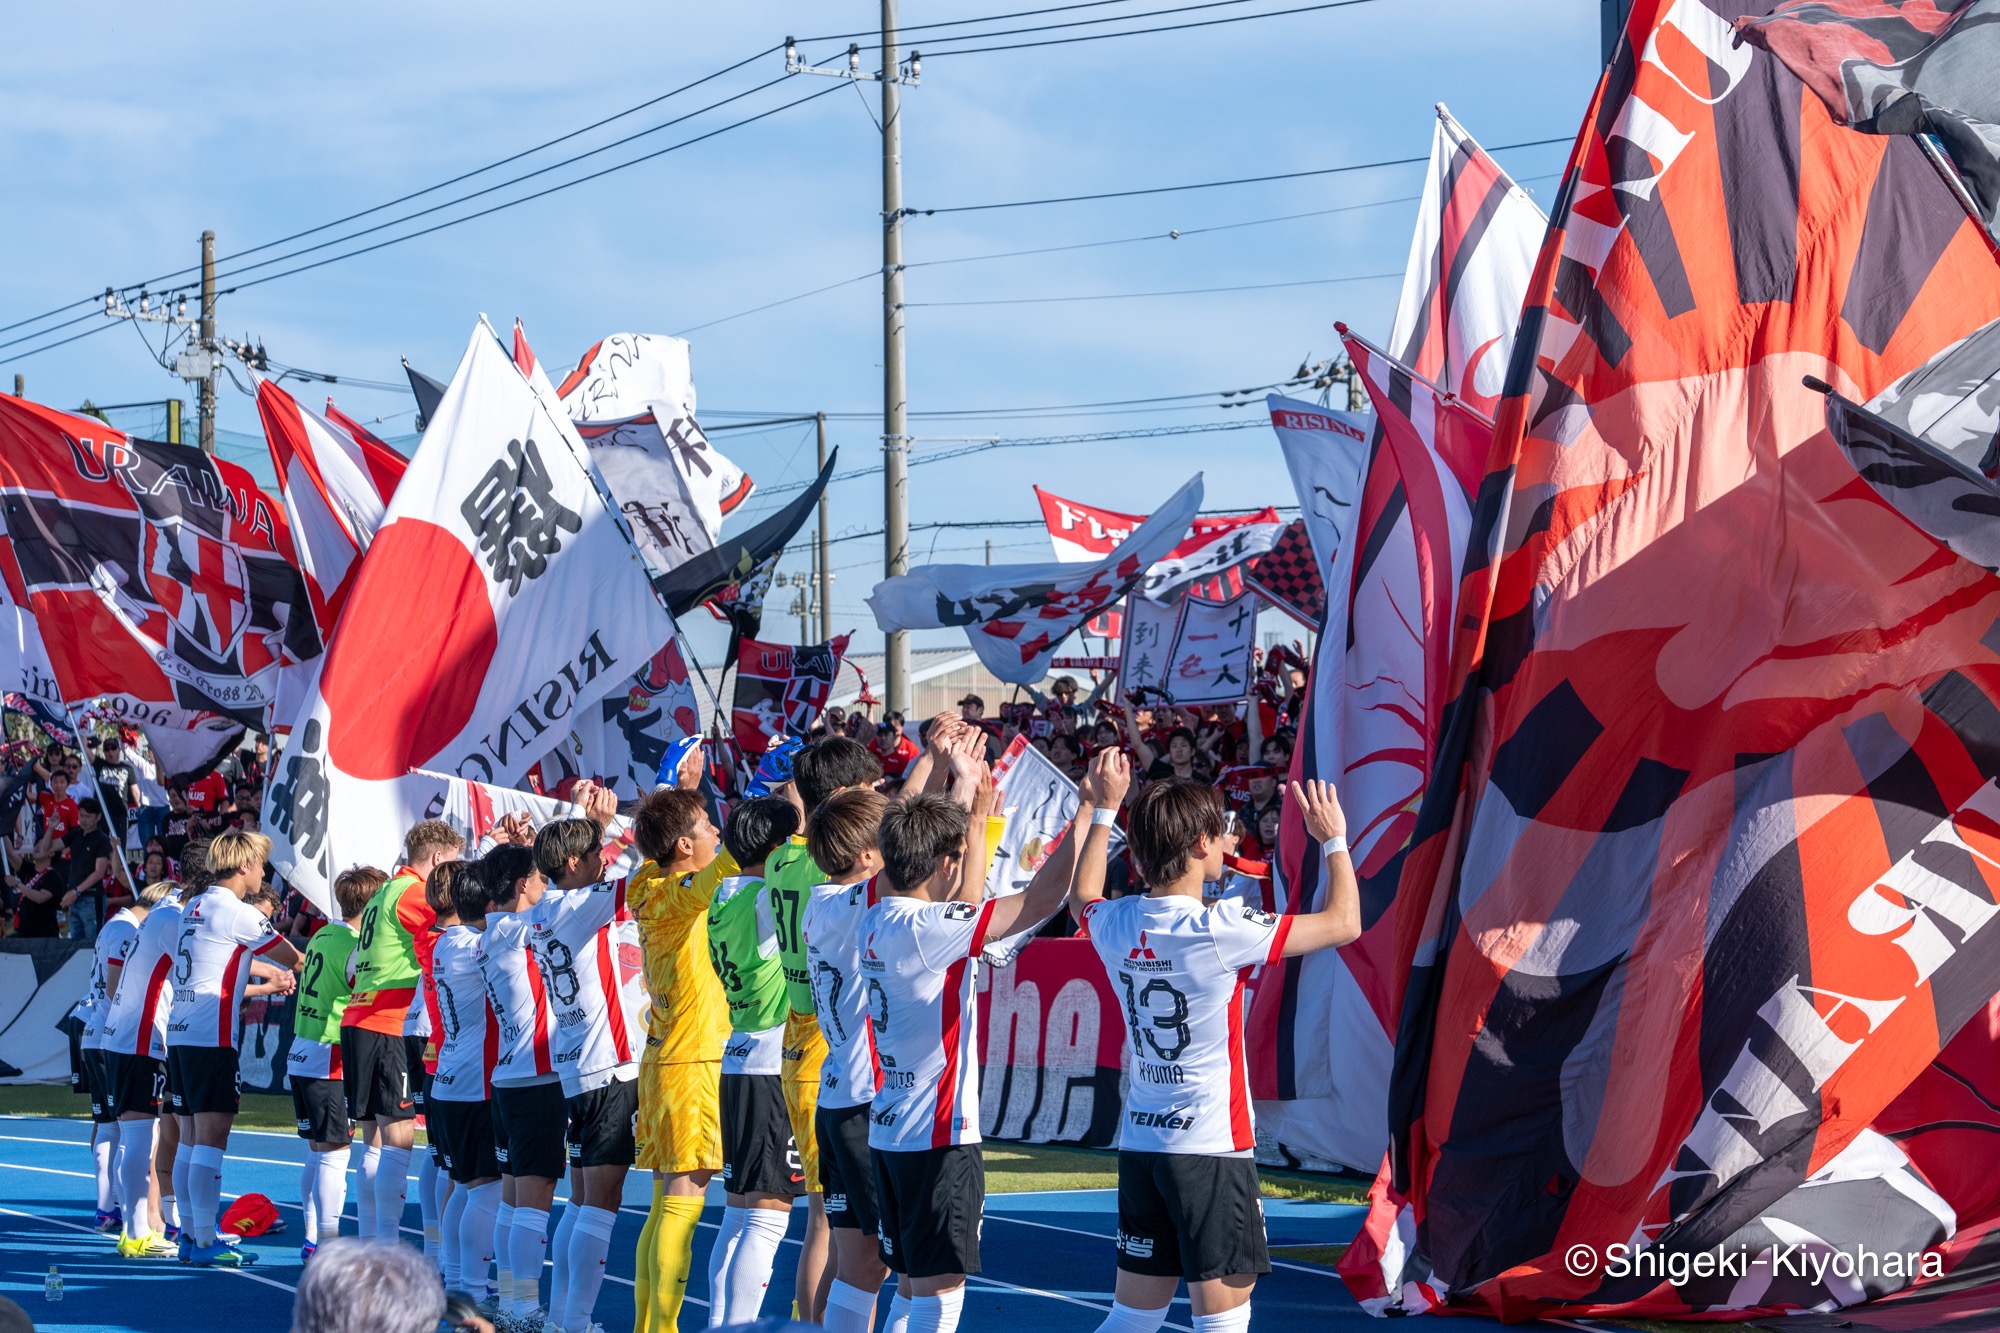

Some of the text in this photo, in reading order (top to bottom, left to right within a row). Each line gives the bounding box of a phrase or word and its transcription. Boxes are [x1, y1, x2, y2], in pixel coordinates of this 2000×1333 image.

[61, 432, 278, 552] URAWA
[175, 929, 196, 986] 5
[772, 887, 799, 954] 37
[978, 950, 1101, 1144] he
[1119, 971, 1191, 1062] 13
